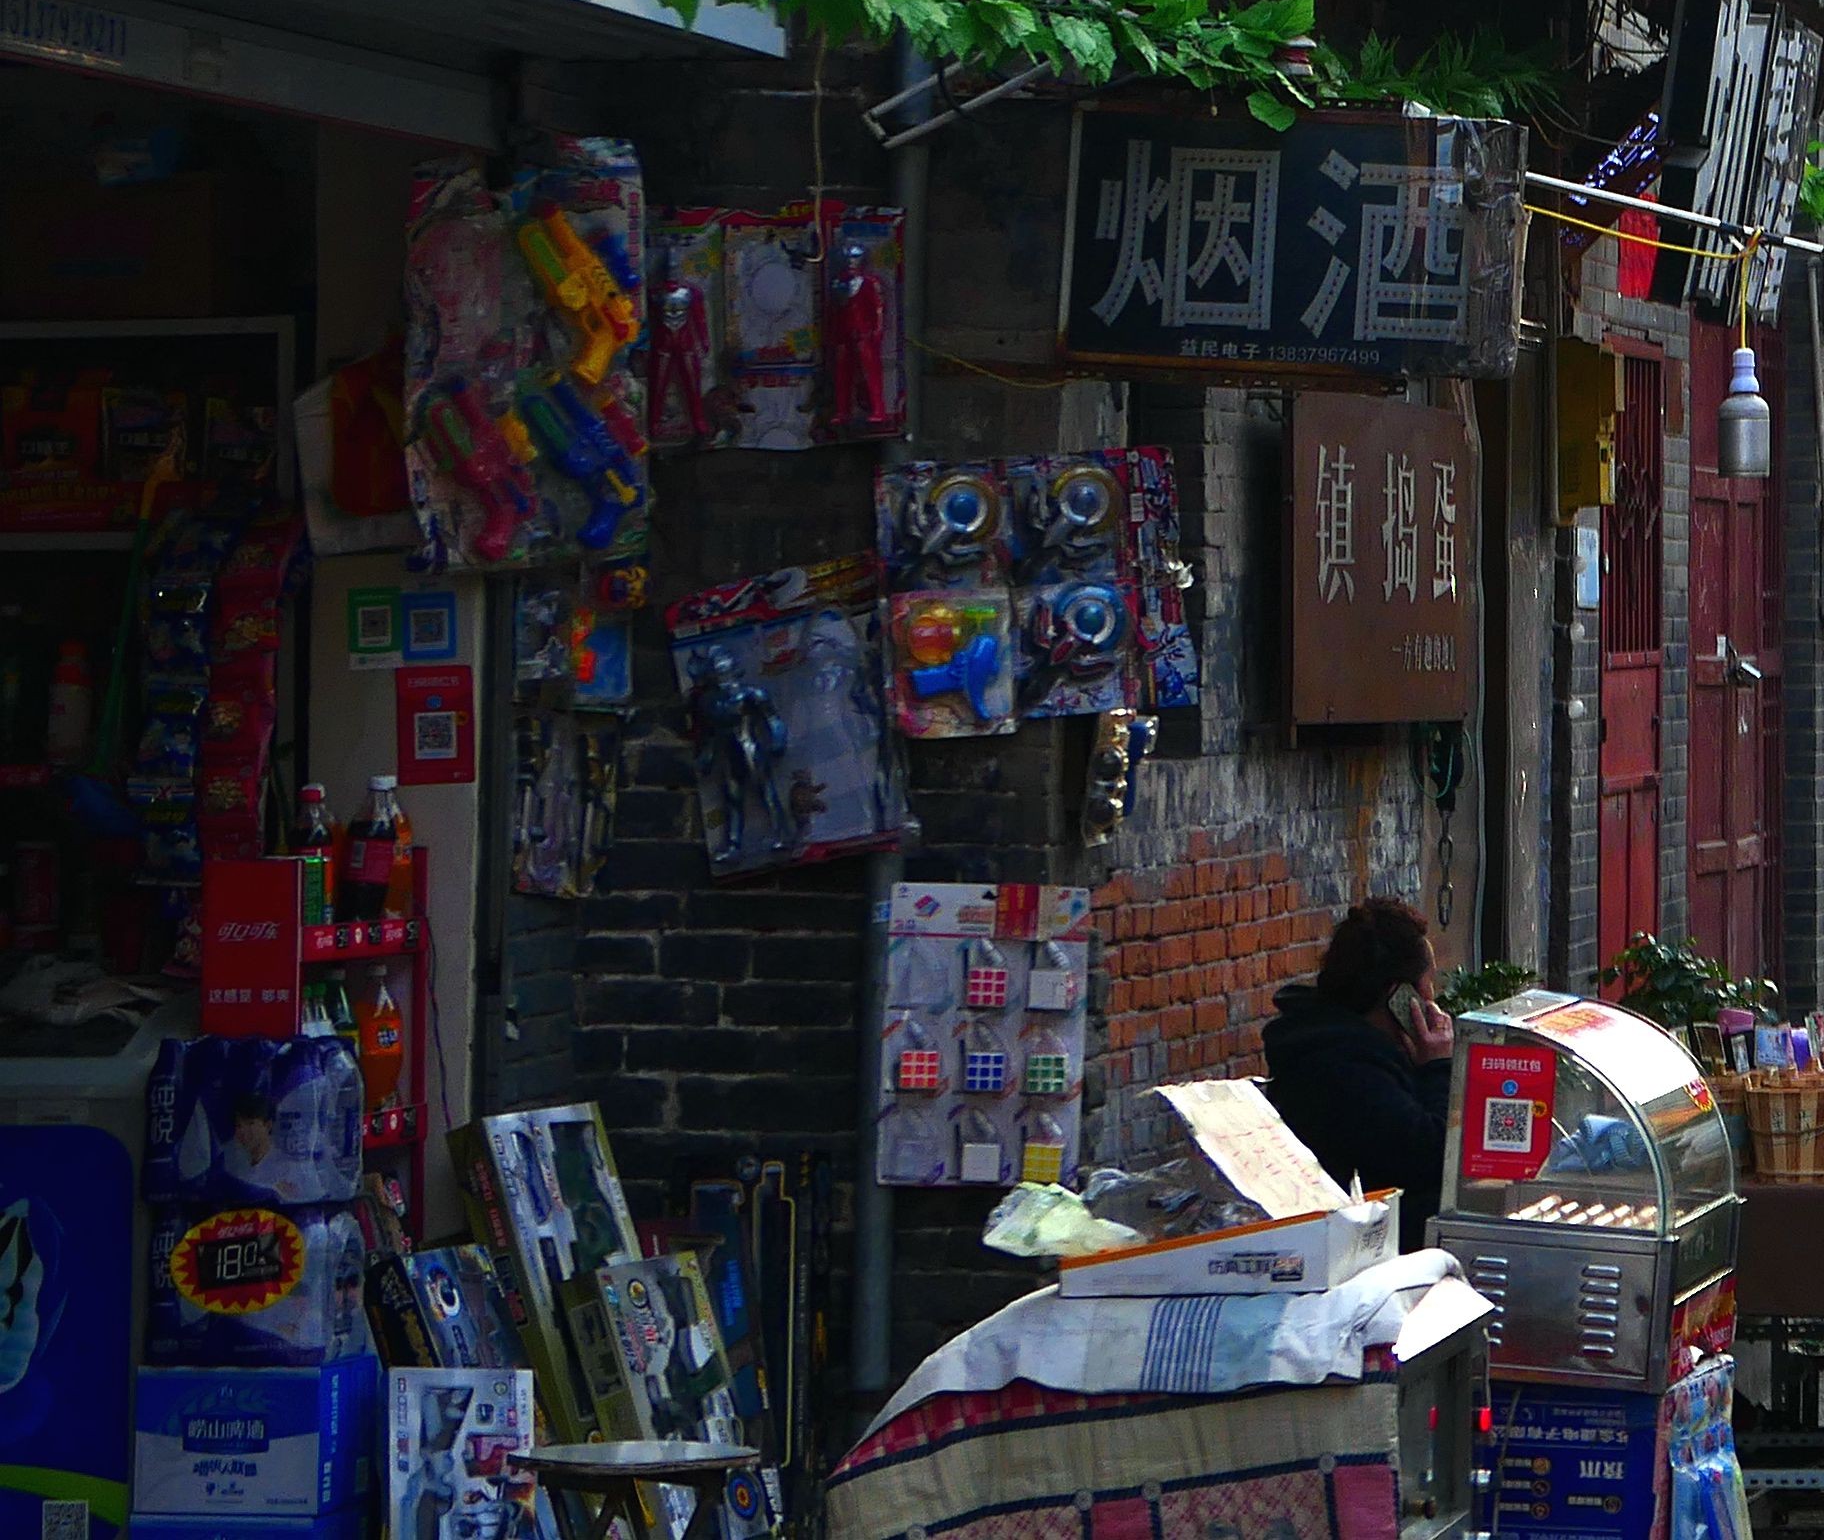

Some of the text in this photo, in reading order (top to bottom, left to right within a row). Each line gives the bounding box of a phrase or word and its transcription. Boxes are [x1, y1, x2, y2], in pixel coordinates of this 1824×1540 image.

[1090, 138, 1469, 345] 烟酒
[1178, 338, 1261, 360] 益民电子
